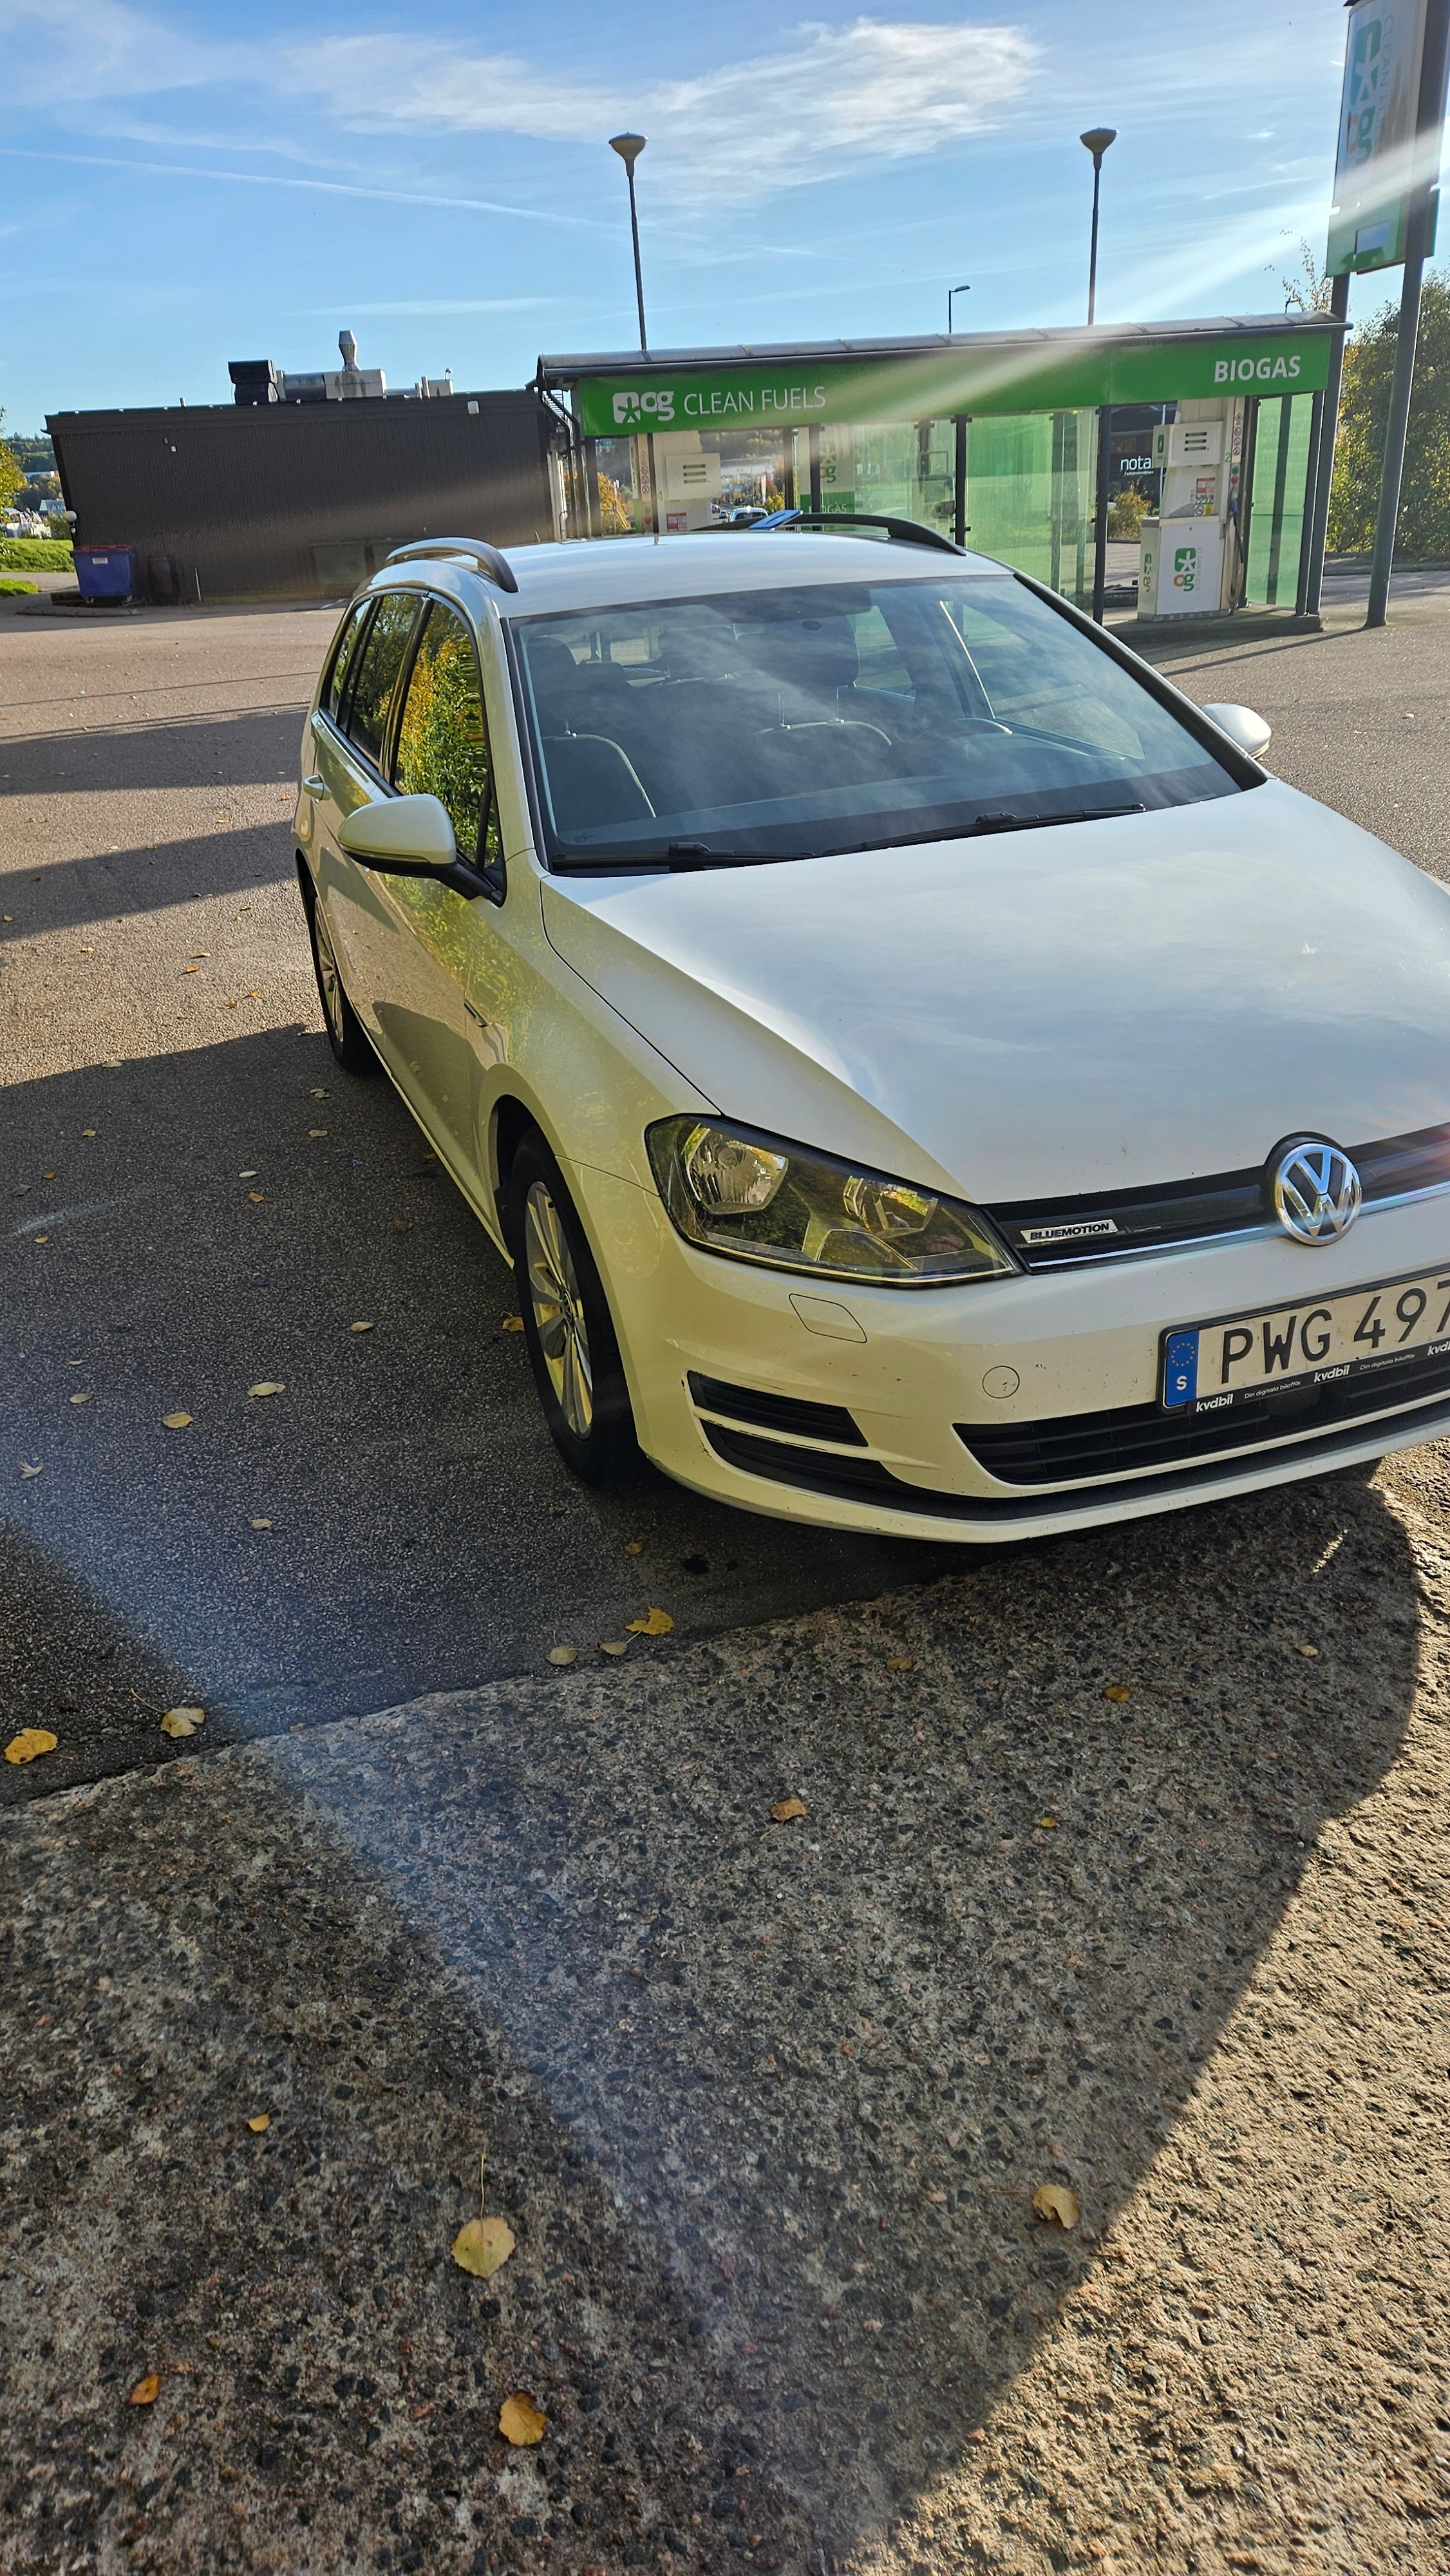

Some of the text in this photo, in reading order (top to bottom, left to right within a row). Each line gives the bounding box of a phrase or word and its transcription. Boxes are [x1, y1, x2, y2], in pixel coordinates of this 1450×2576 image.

[1214, 355, 1301, 383] BIOGAS
[684, 390, 754, 415] CLEAN
[762, 386, 826, 411] FUELS
[1120, 455, 1151, 471] nota
[1224, 452, 1231, 462] 2
[1030, 1223, 1109, 1240] BLUEMOTION
[1221, 1308, 1333, 1385] PWG
[1176, 1375, 1187, 1391] S
[1256, 1386, 1279, 1397] digitala
[1371, 1358, 1393, 1368] digitala
